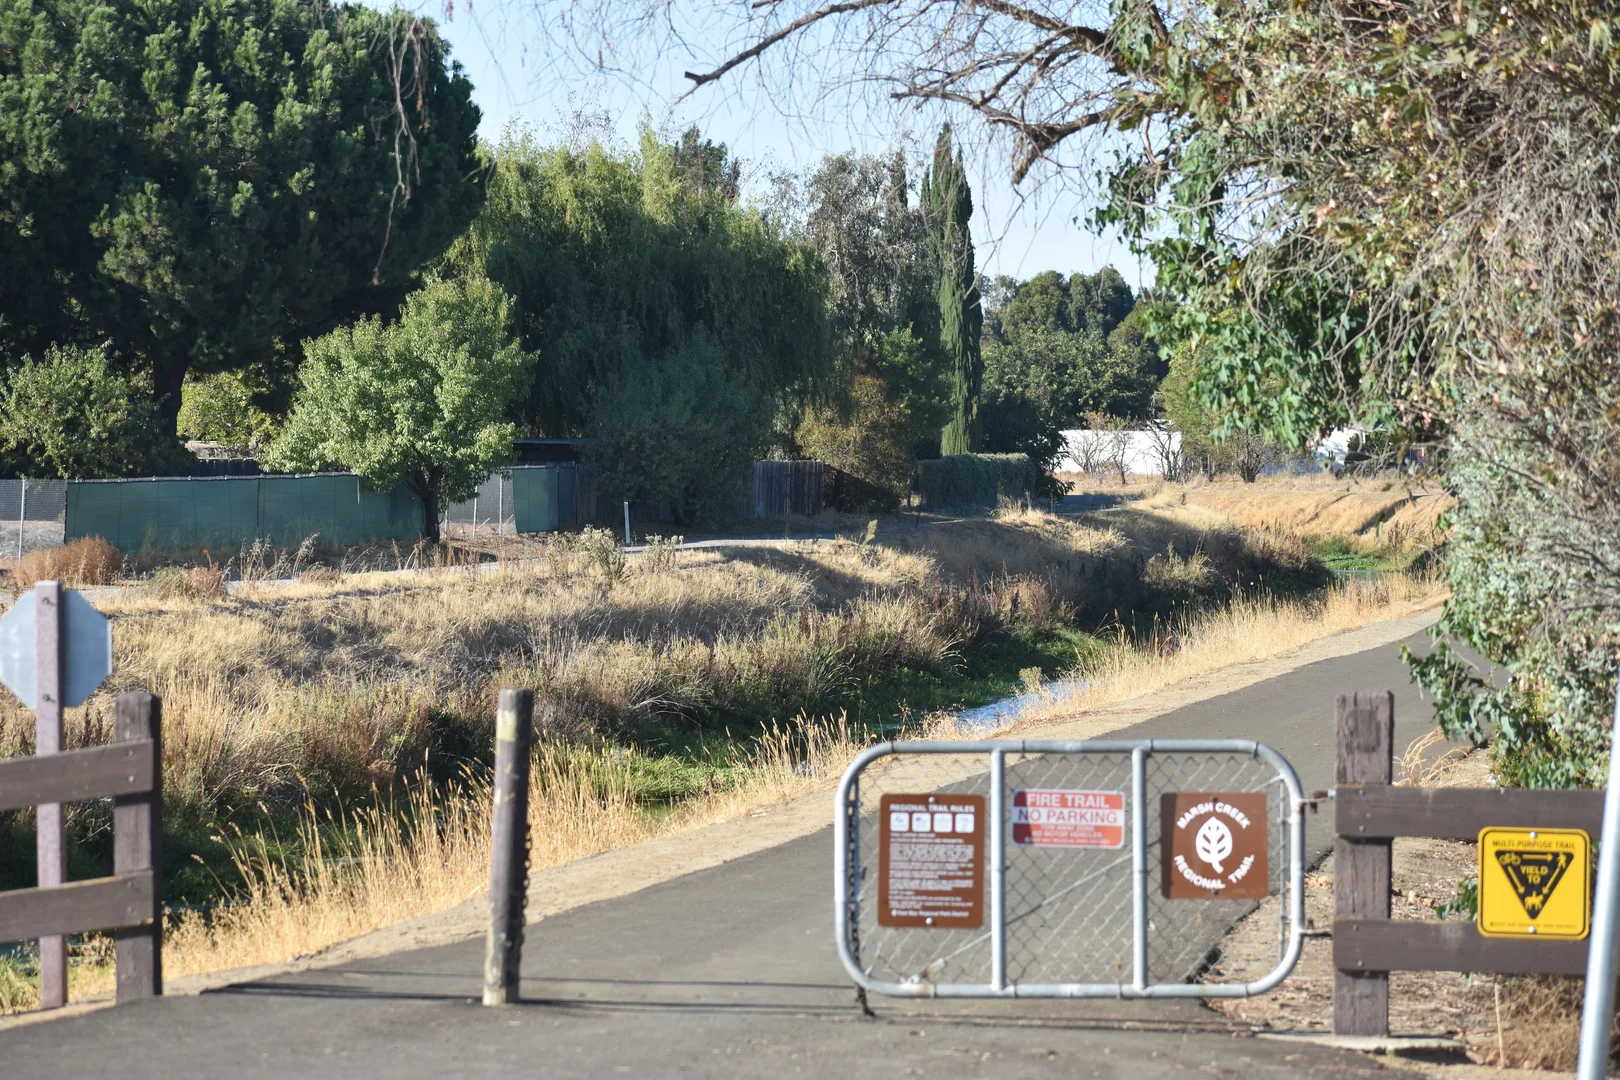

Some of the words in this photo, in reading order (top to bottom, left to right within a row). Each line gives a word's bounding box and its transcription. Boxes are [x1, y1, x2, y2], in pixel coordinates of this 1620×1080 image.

[1027, 793, 1060, 807] FIRE
[1064, 794, 1110, 809] TRAIL
[890, 804, 927, 812] REGIONAL
[928, 804, 949, 812] TRAIL
[950, 805, 975, 814] RULES
[1176, 802, 1214, 829] MARSH
[1215, 802, 1251, 829] CREEK
[1018, 809, 1041, 821] NO
[1047, 809, 1118, 824] PARKING
[1492, 840, 1552, 849] MULTI-PURPOSE
[1556, 842, 1576, 850] TRAIL
[1174, 854, 1226, 890] REGIONAL
[1228, 854, 1254, 884] TRAIL
[1520, 865, 1549, 876] YIELD
[1528, 875, 1542, 884] TO
